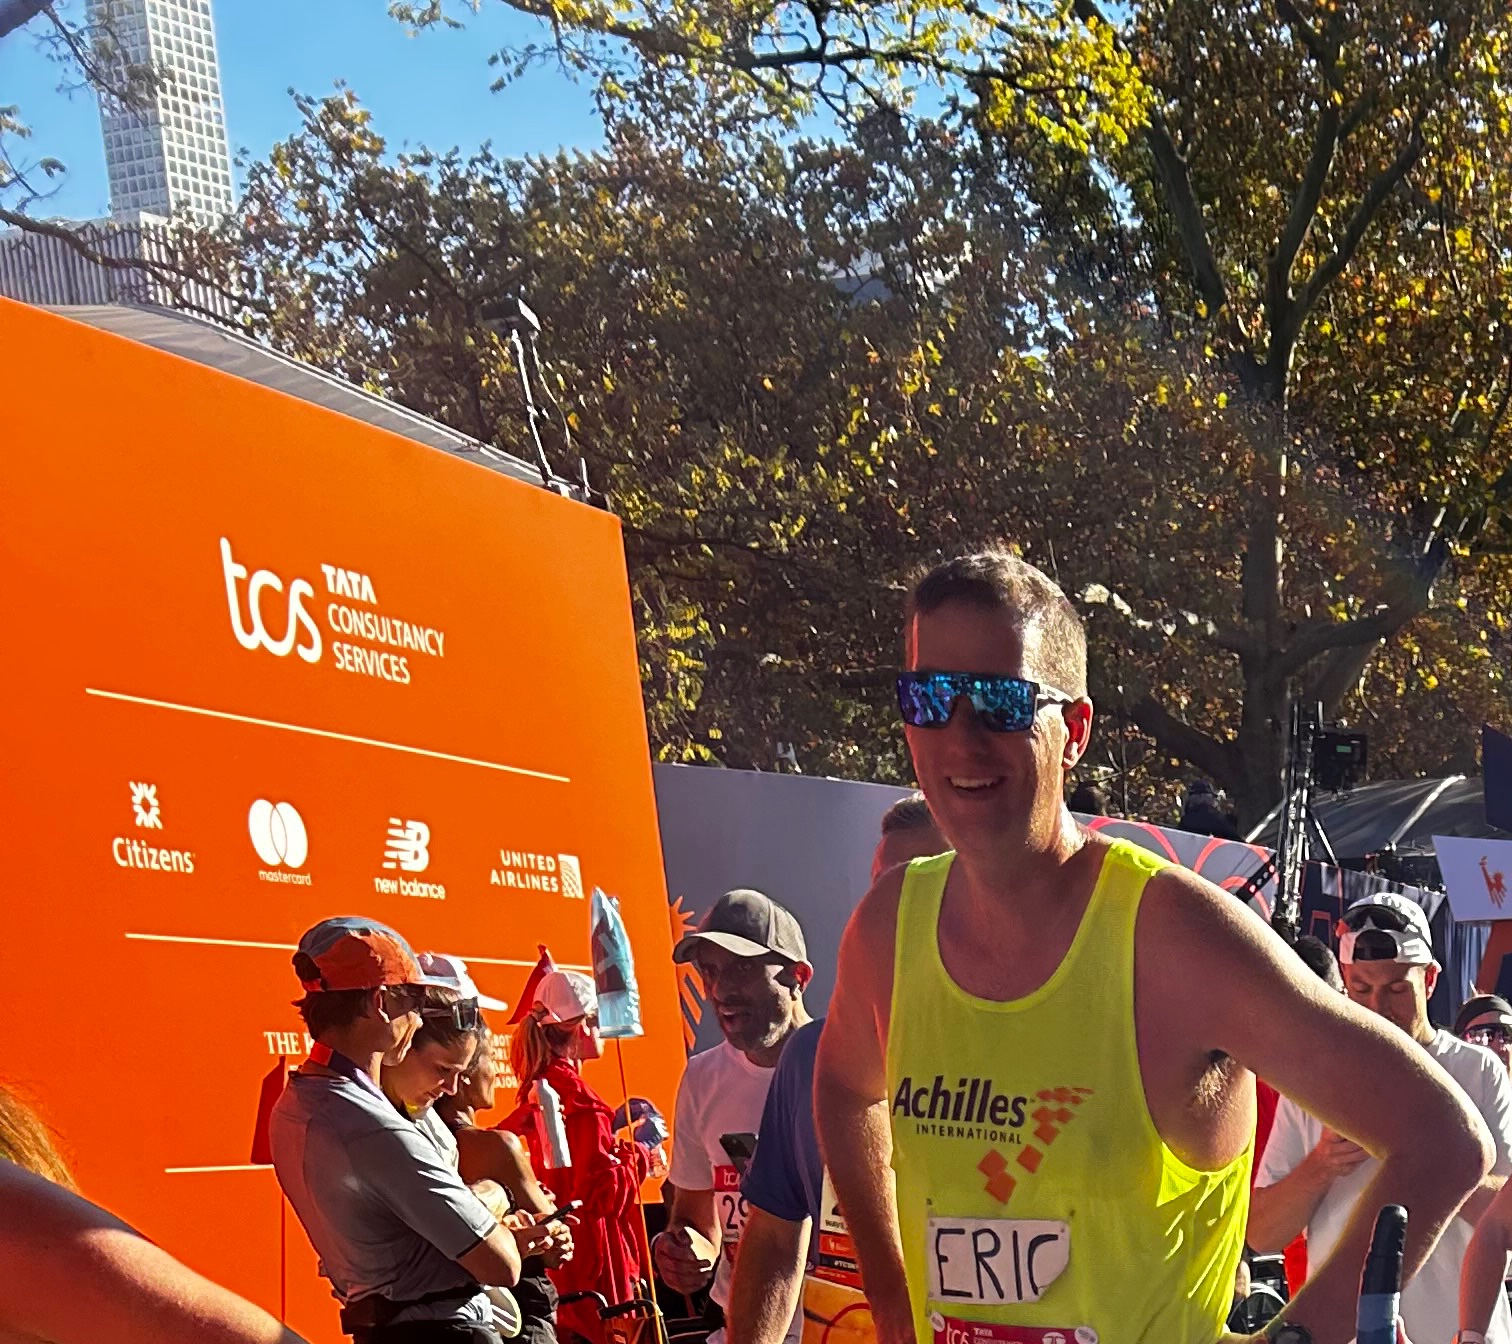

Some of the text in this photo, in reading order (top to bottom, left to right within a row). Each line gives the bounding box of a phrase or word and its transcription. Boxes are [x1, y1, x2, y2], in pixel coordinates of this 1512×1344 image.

[219, 536, 322, 663] tcs
[320, 563, 377, 605] TATA
[328, 603, 444, 657] CONSULTANCY
[332, 642, 410, 684] SERVICES
[113, 837, 194, 874] Citizens
[500, 849, 556, 873] UNITED
[258, 869, 312, 886] mastercard
[374, 877, 446, 899] new balance
[490, 869, 559, 893] AIRLINES
[263, 1031, 301, 1055] THE
[892, 1075, 1027, 1128] Achilles
[916, 1124, 1022, 1145] INTERNATIONAL
[935, 1228, 1058, 1300] ERIC
